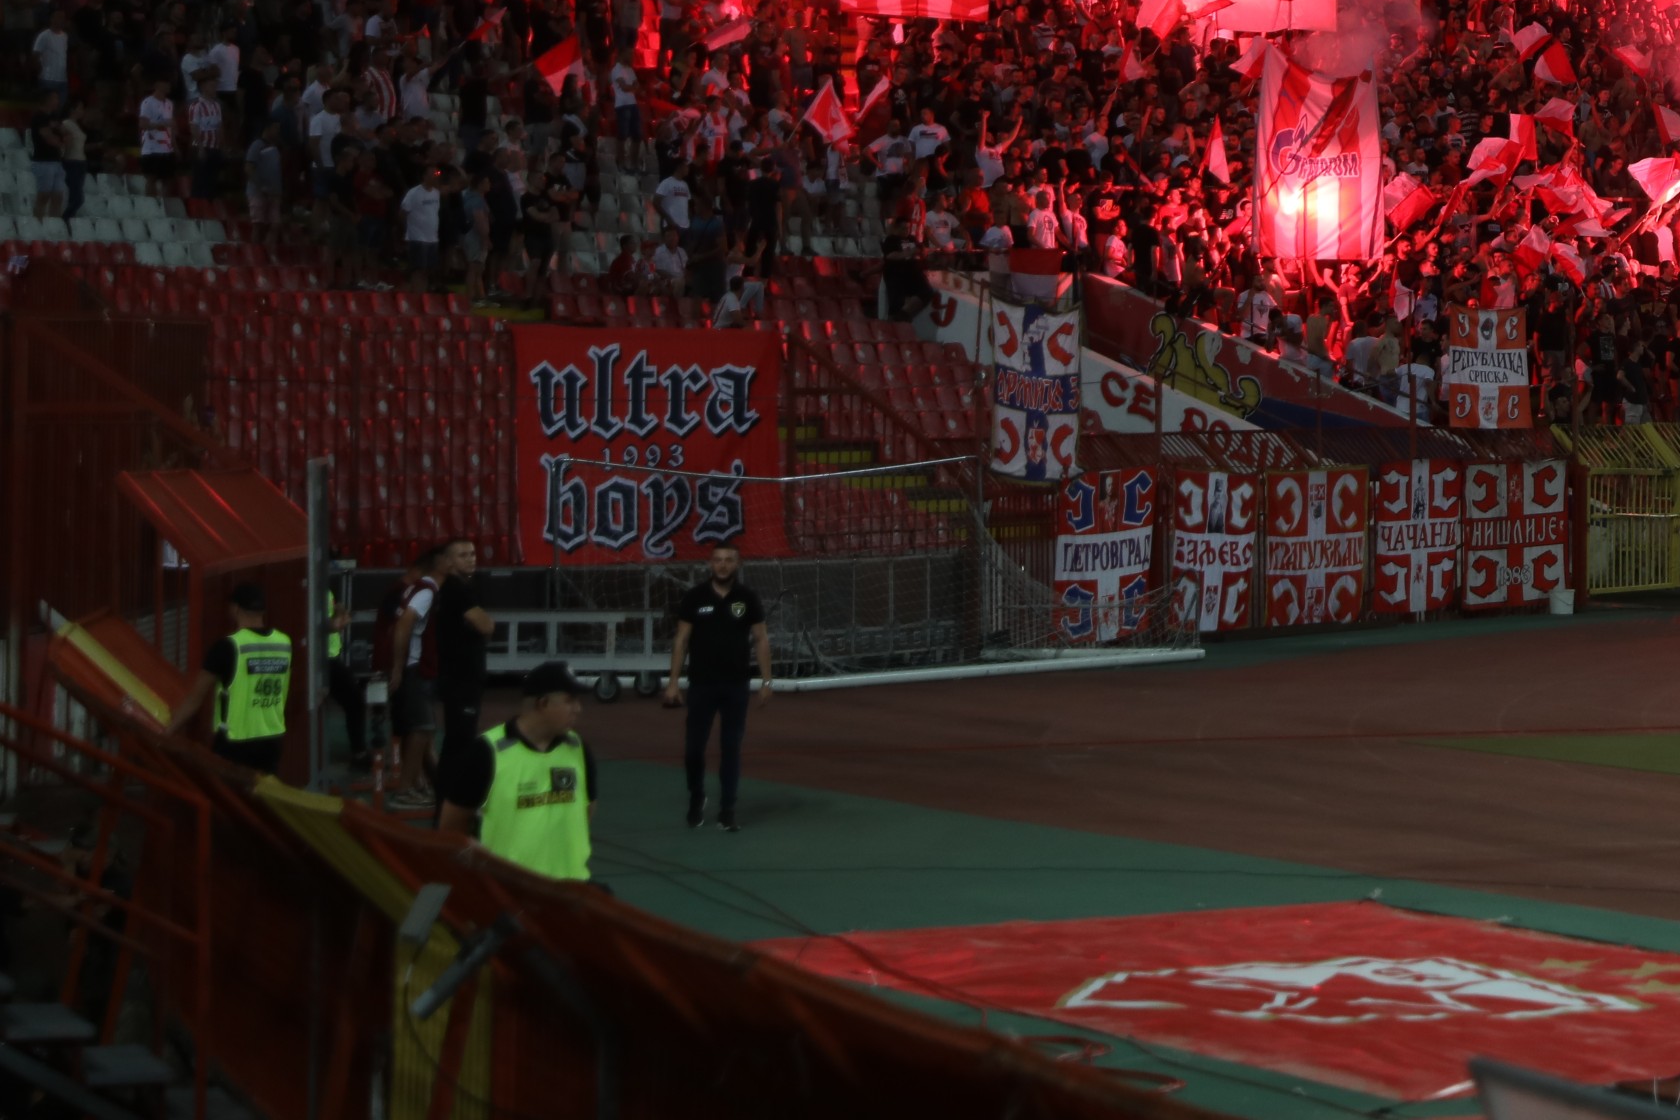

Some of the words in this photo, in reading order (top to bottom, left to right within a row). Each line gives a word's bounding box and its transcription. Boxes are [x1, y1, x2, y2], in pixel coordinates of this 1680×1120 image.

[1451, 348, 1525, 377] РЕПУБЛИКА
[1468, 370, 1509, 384] СРПСКА
[529, 342, 760, 442] ultra
[601, 444, 686, 472] 1993
[539, 452, 747, 559] boys
[1381, 520, 1458, 552] ЧАЧАНИ
[1472, 516, 1559, 547] НИШЛИЈЕ
